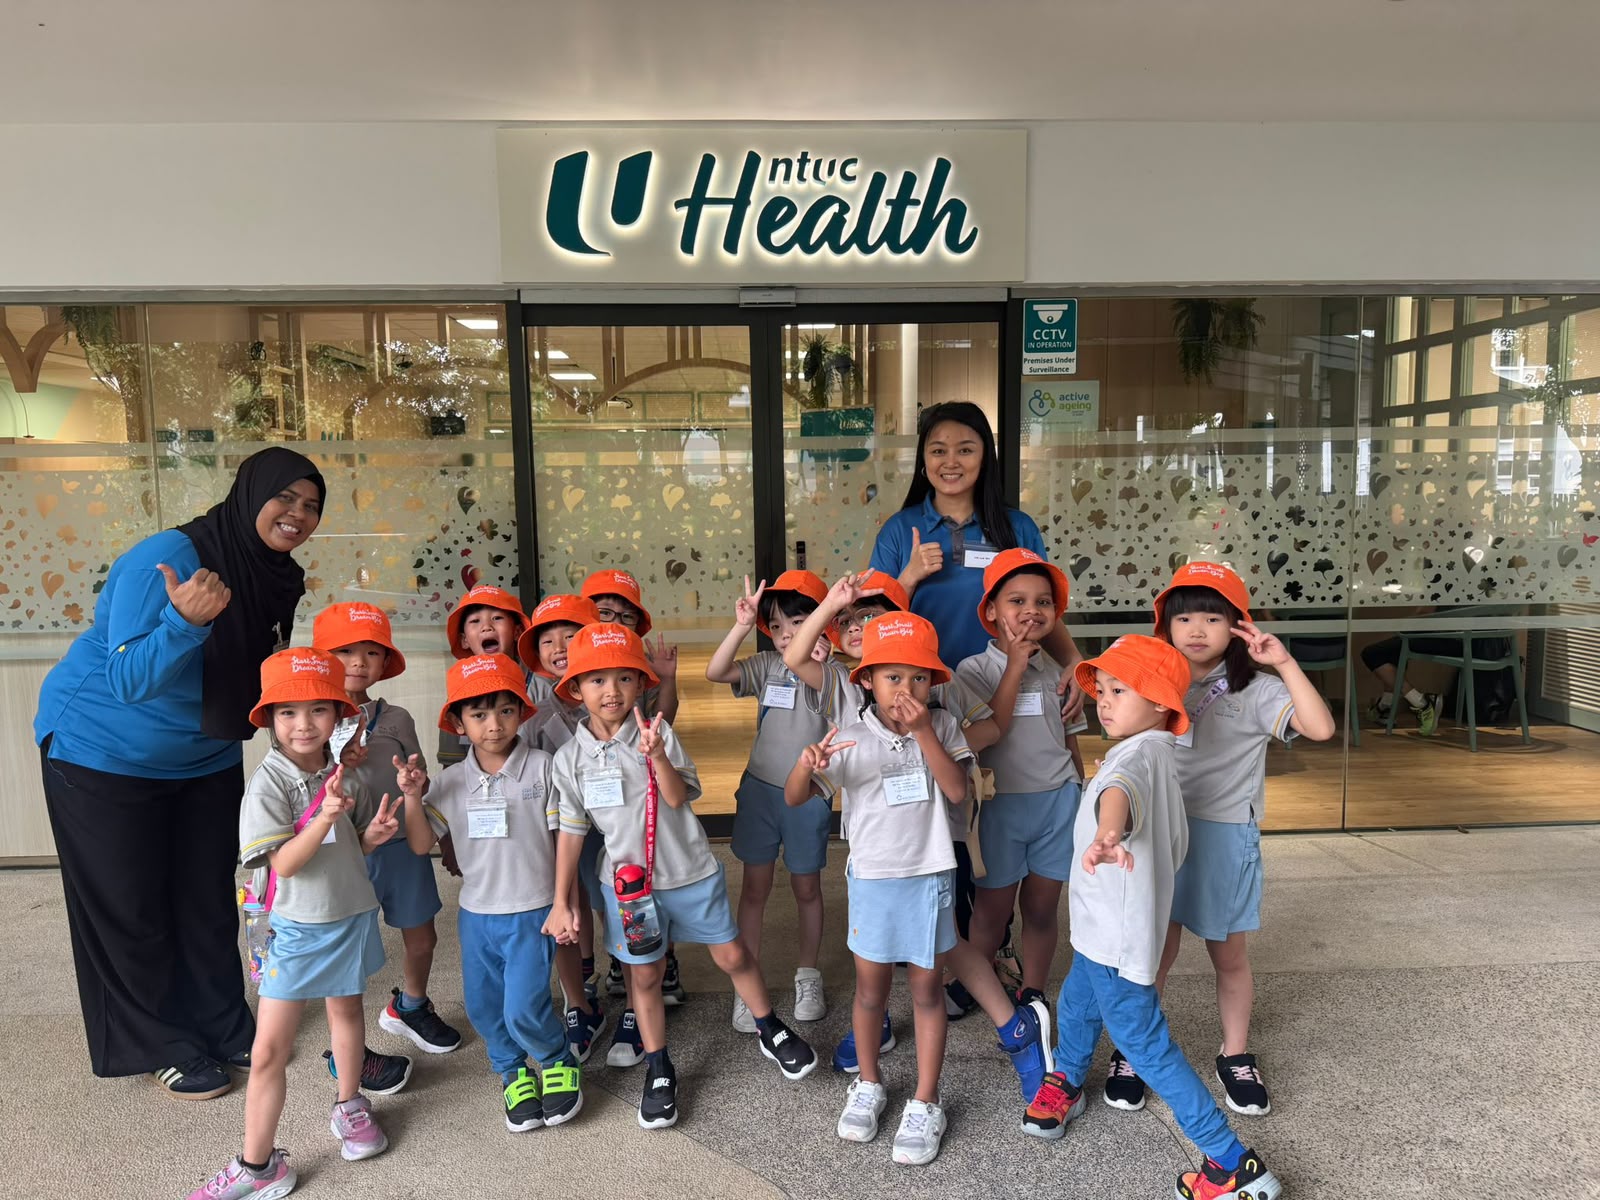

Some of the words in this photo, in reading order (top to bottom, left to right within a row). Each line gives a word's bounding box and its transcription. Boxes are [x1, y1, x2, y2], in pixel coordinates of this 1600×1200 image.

[768, 151, 858, 184] ntuc
[674, 150, 979, 256] Health
[1032, 329, 1067, 340] CCTV
[1036, 341, 1072, 349] OPERATION
[1054, 356, 1075, 364] Under
[1058, 392, 1090, 401] active
[1058, 401, 1092, 412] ageing
[894, 619, 913, 628] Small
[772, 1029, 789, 1047] NIKE
[652, 1077, 671, 1090] NIKE
